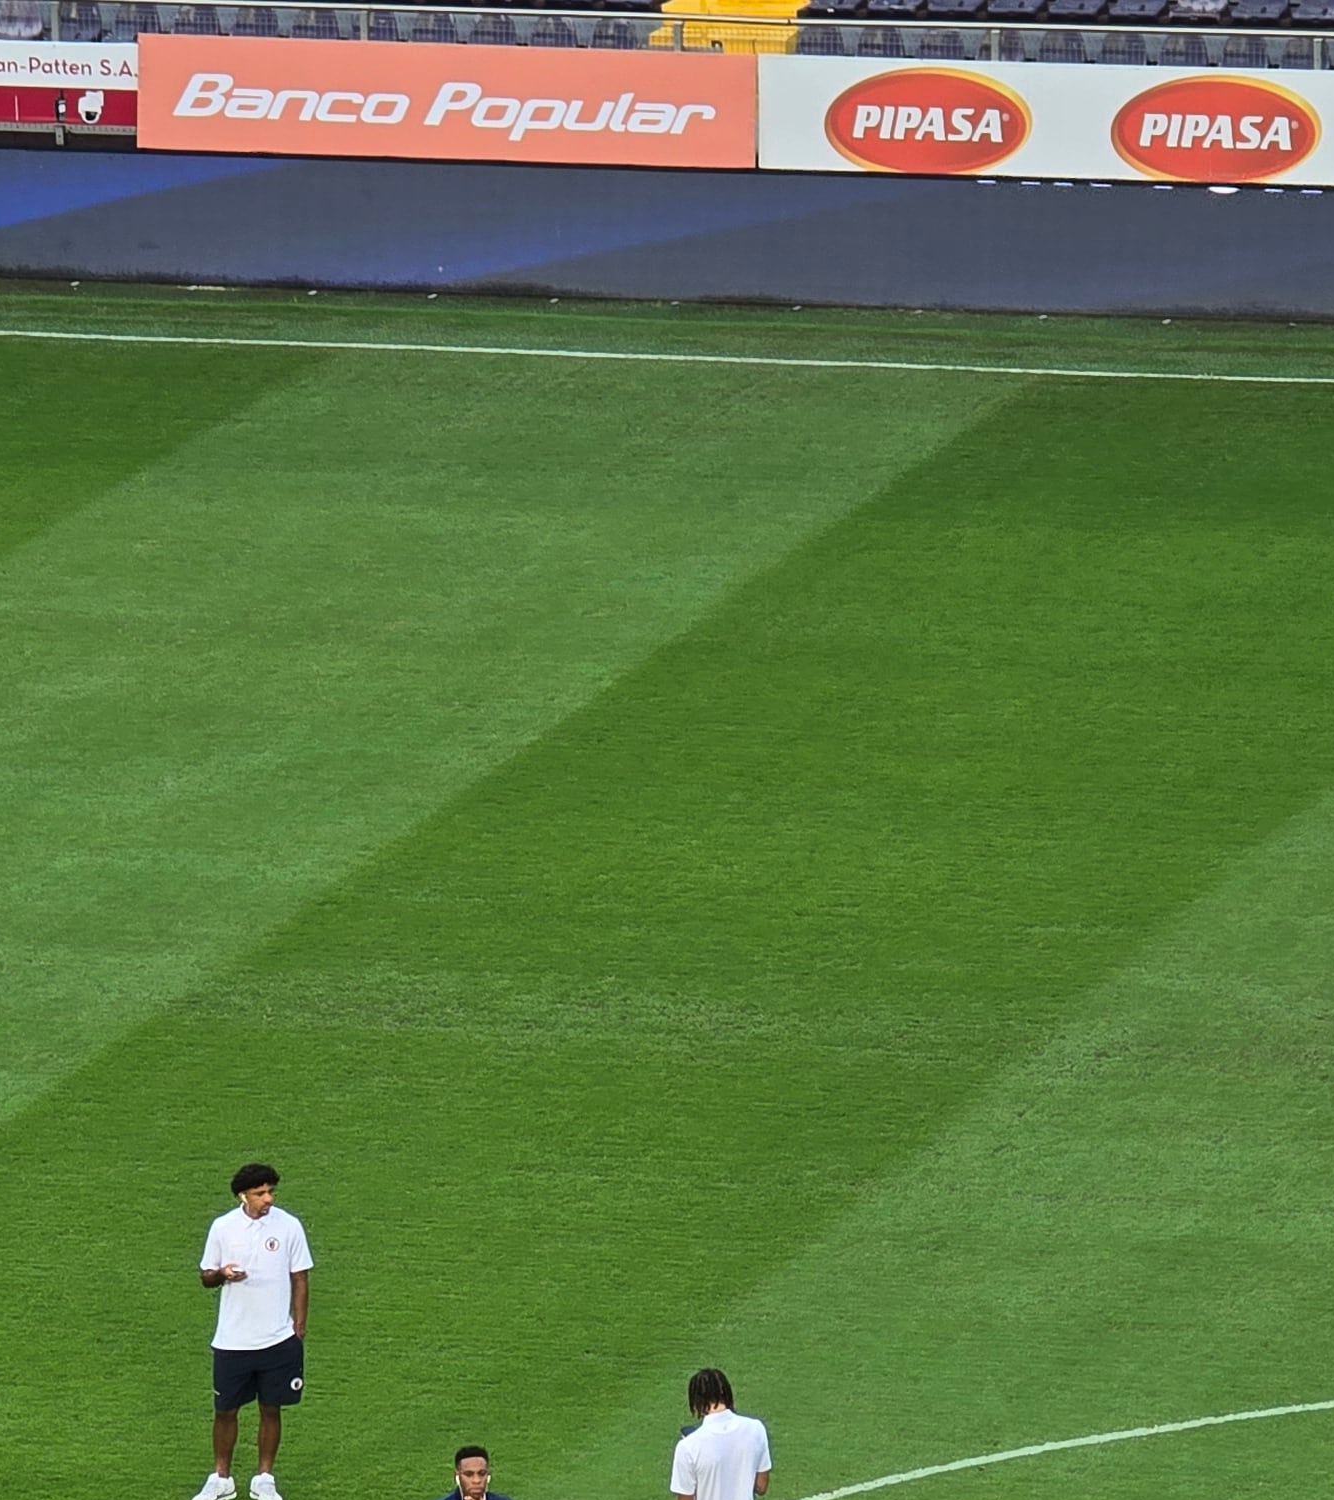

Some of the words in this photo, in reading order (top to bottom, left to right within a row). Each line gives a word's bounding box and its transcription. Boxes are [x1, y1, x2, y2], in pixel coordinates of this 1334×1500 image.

[100, 59, 138, 77] S.A.
[173, 73, 410, 124] Banco
[423, 81, 716, 141] Popular
[852, 105, 1004, 143] PIPASA
[1138, 113, 1292, 151] PIPASA
